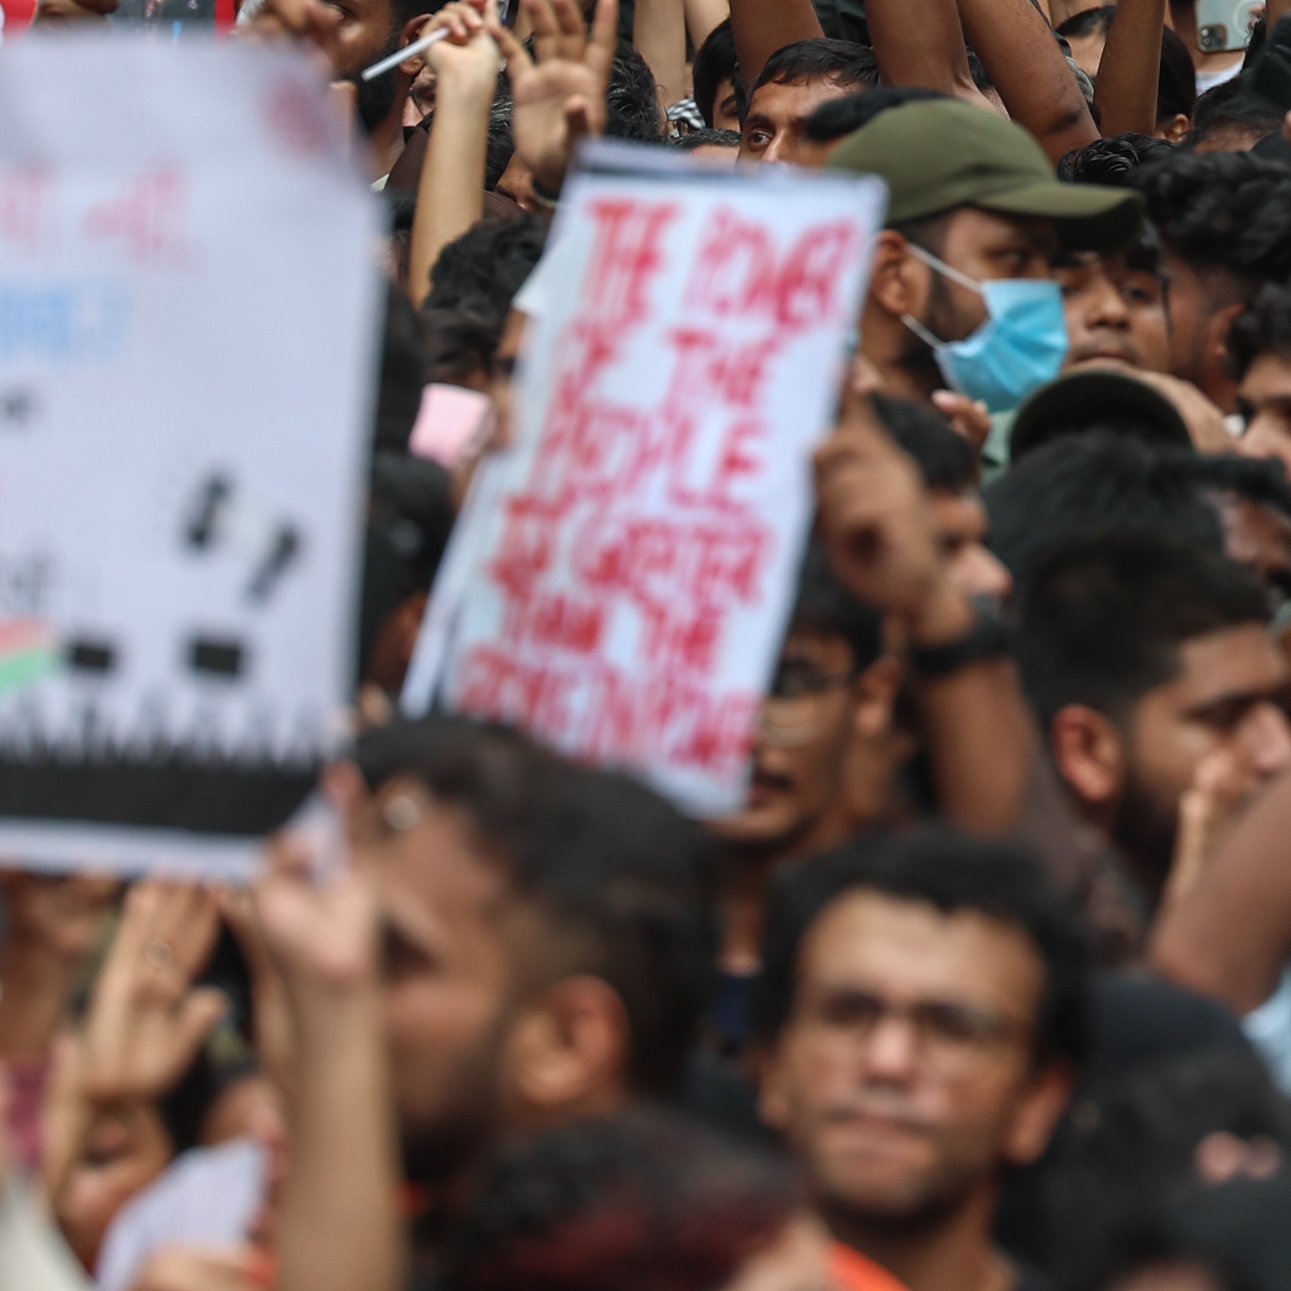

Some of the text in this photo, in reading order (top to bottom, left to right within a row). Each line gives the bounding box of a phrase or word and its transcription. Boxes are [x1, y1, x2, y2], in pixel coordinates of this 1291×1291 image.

[585, 198, 858, 328] THE POWER
[664, 327, 790, 408] THE
